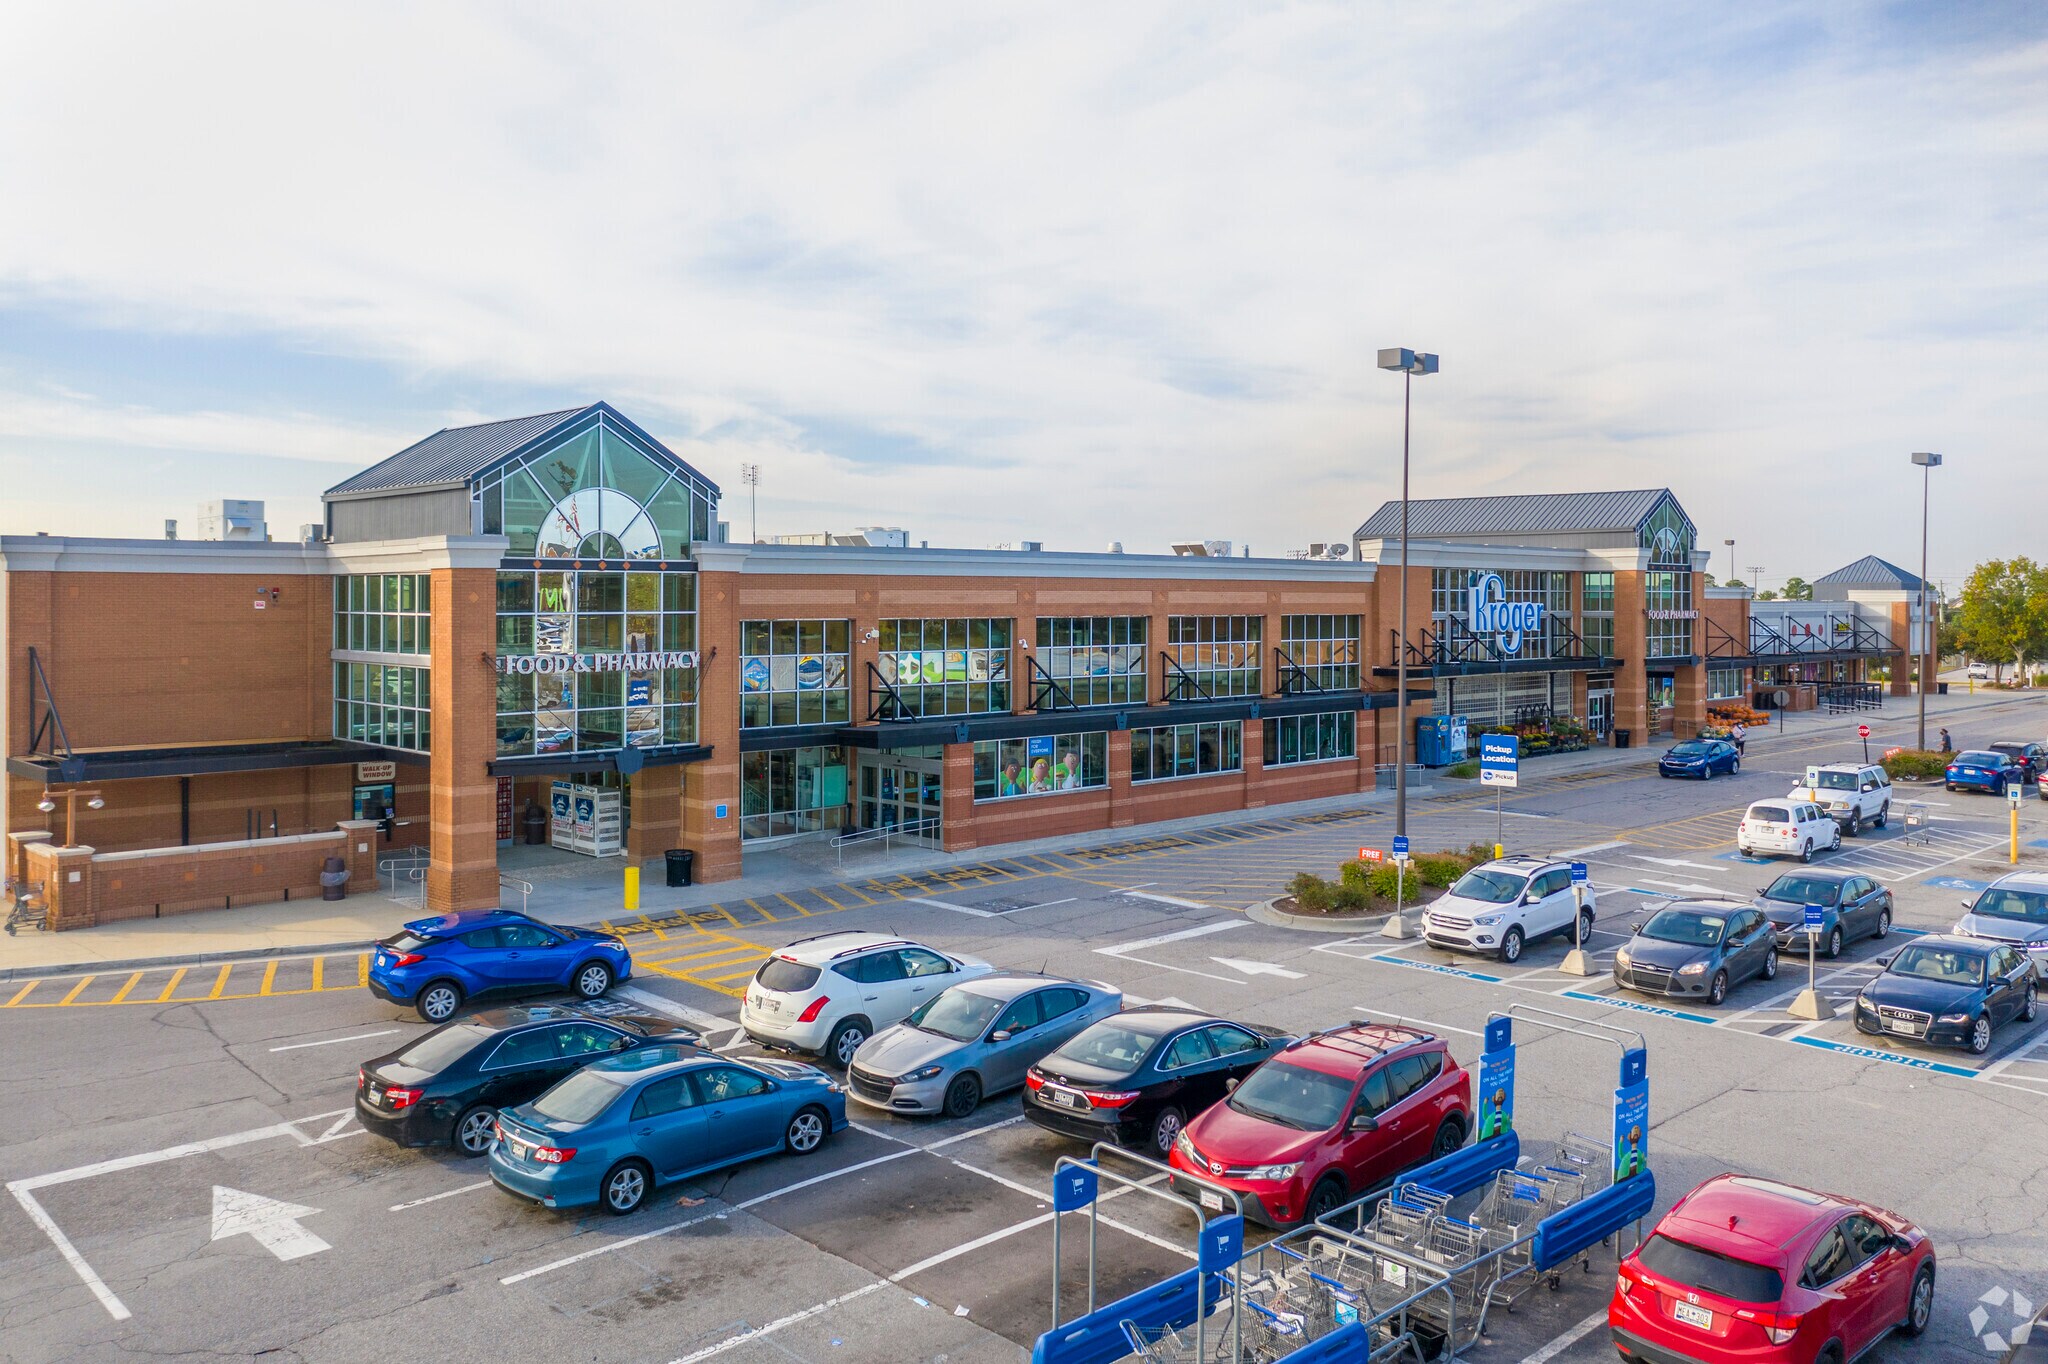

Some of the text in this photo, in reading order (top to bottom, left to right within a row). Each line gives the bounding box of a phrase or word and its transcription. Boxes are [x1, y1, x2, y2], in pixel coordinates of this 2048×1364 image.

[1471, 573, 1544, 654] Kroger
[1648, 610, 1664, 619] FOOD
[1670, 610, 1699, 619] PHARMACY
[506, 651, 700, 675] FOOD & PHARMACY
[1485, 745, 1512, 754] Pickup
[1481, 754, 1516, 763] Location
[362, 764, 392, 772] WALK-UP
[1362, 849, 1380, 859] FREE
[1834, 1046, 1934, 1070] PICKUP
[1696, 1312, 1709, 1323] 303
